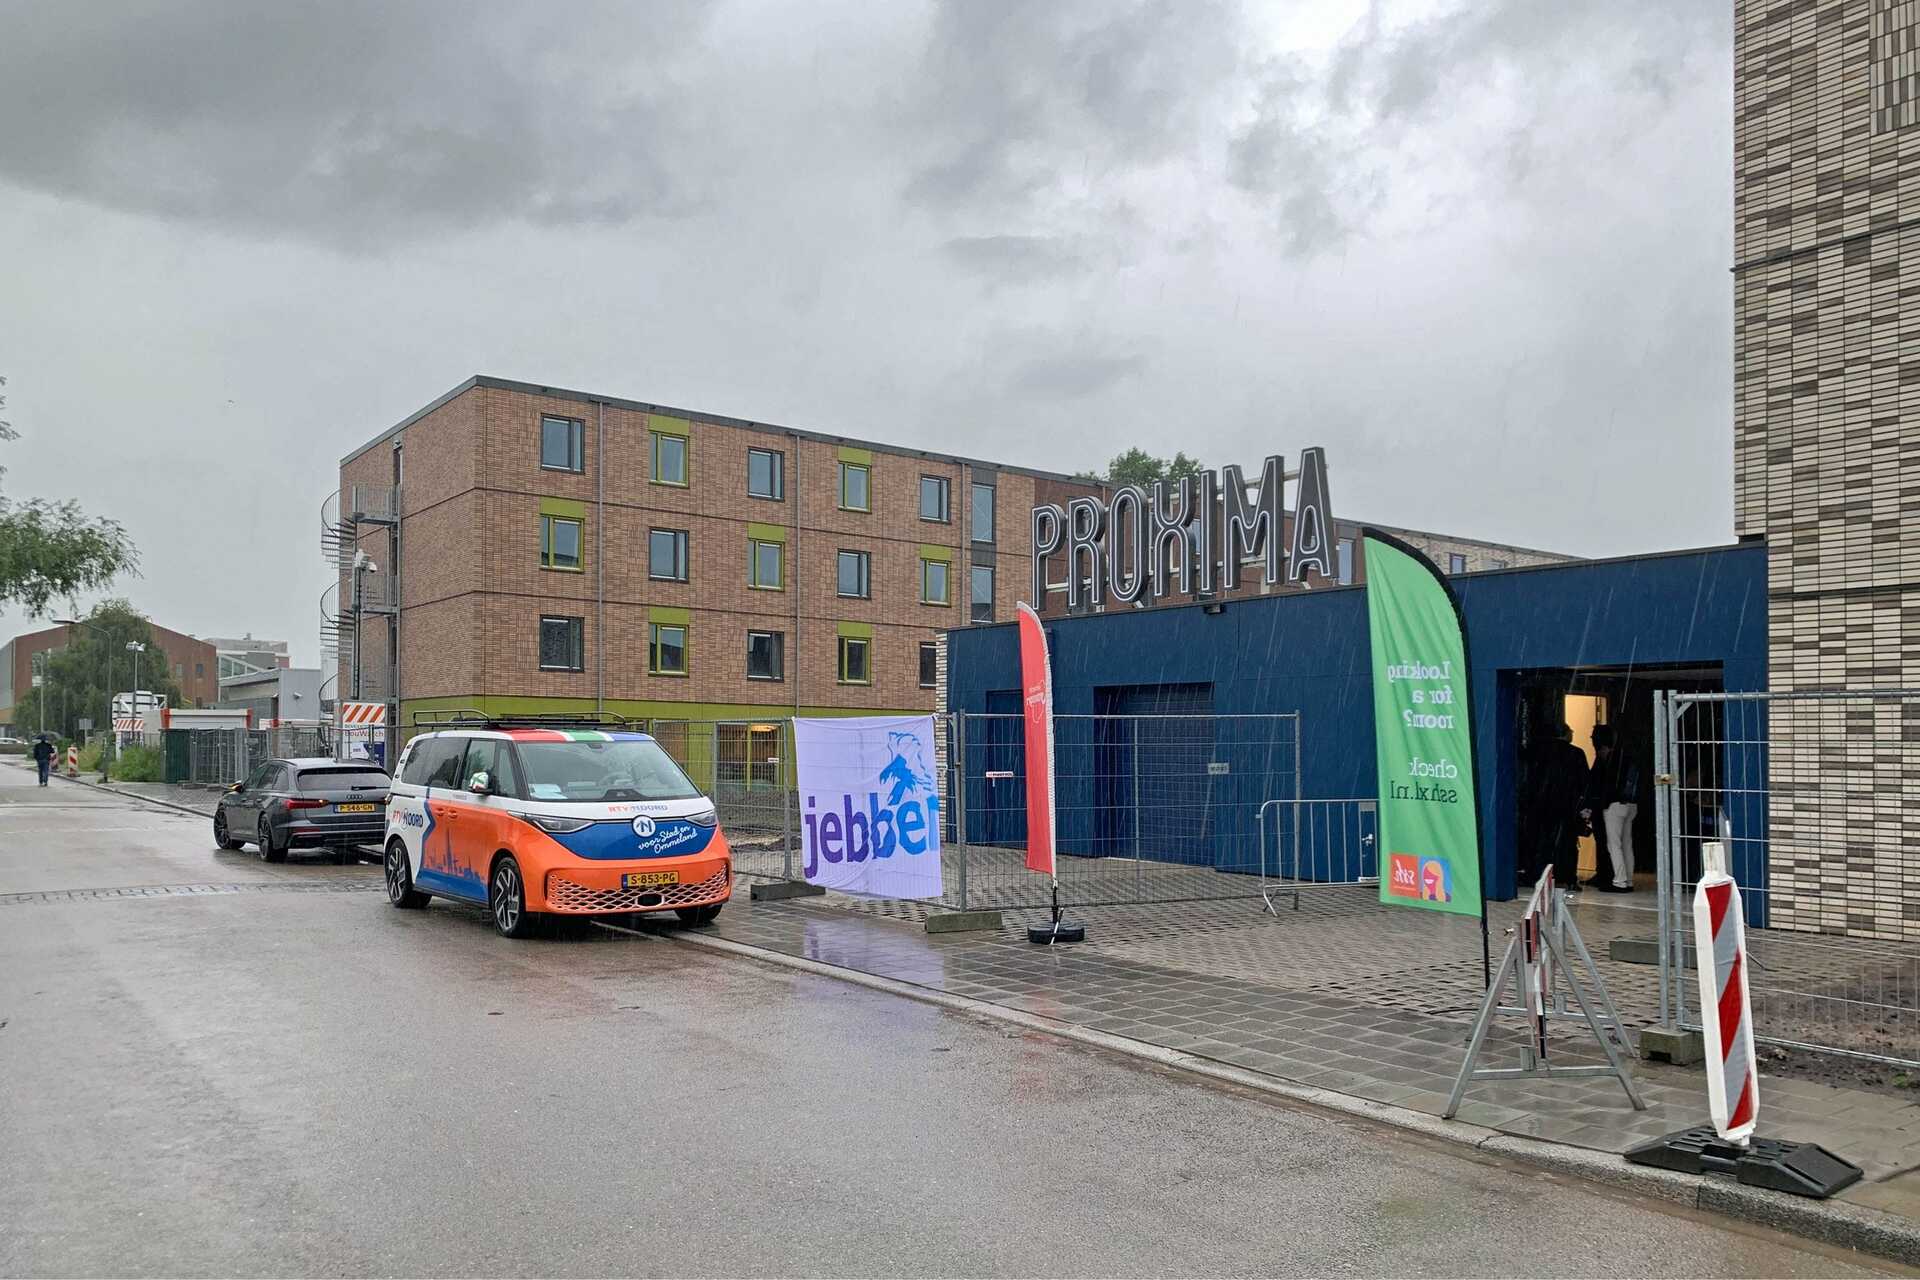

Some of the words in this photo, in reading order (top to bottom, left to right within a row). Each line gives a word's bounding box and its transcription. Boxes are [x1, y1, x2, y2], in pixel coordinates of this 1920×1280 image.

[1031, 446, 1336, 610] PROXIMA
[638, 837, 660, 850] voor
[660, 825, 680, 843] Stad
[653, 828, 698, 854] Ommeland
[631, 872, 676, 885] S-853-PG
